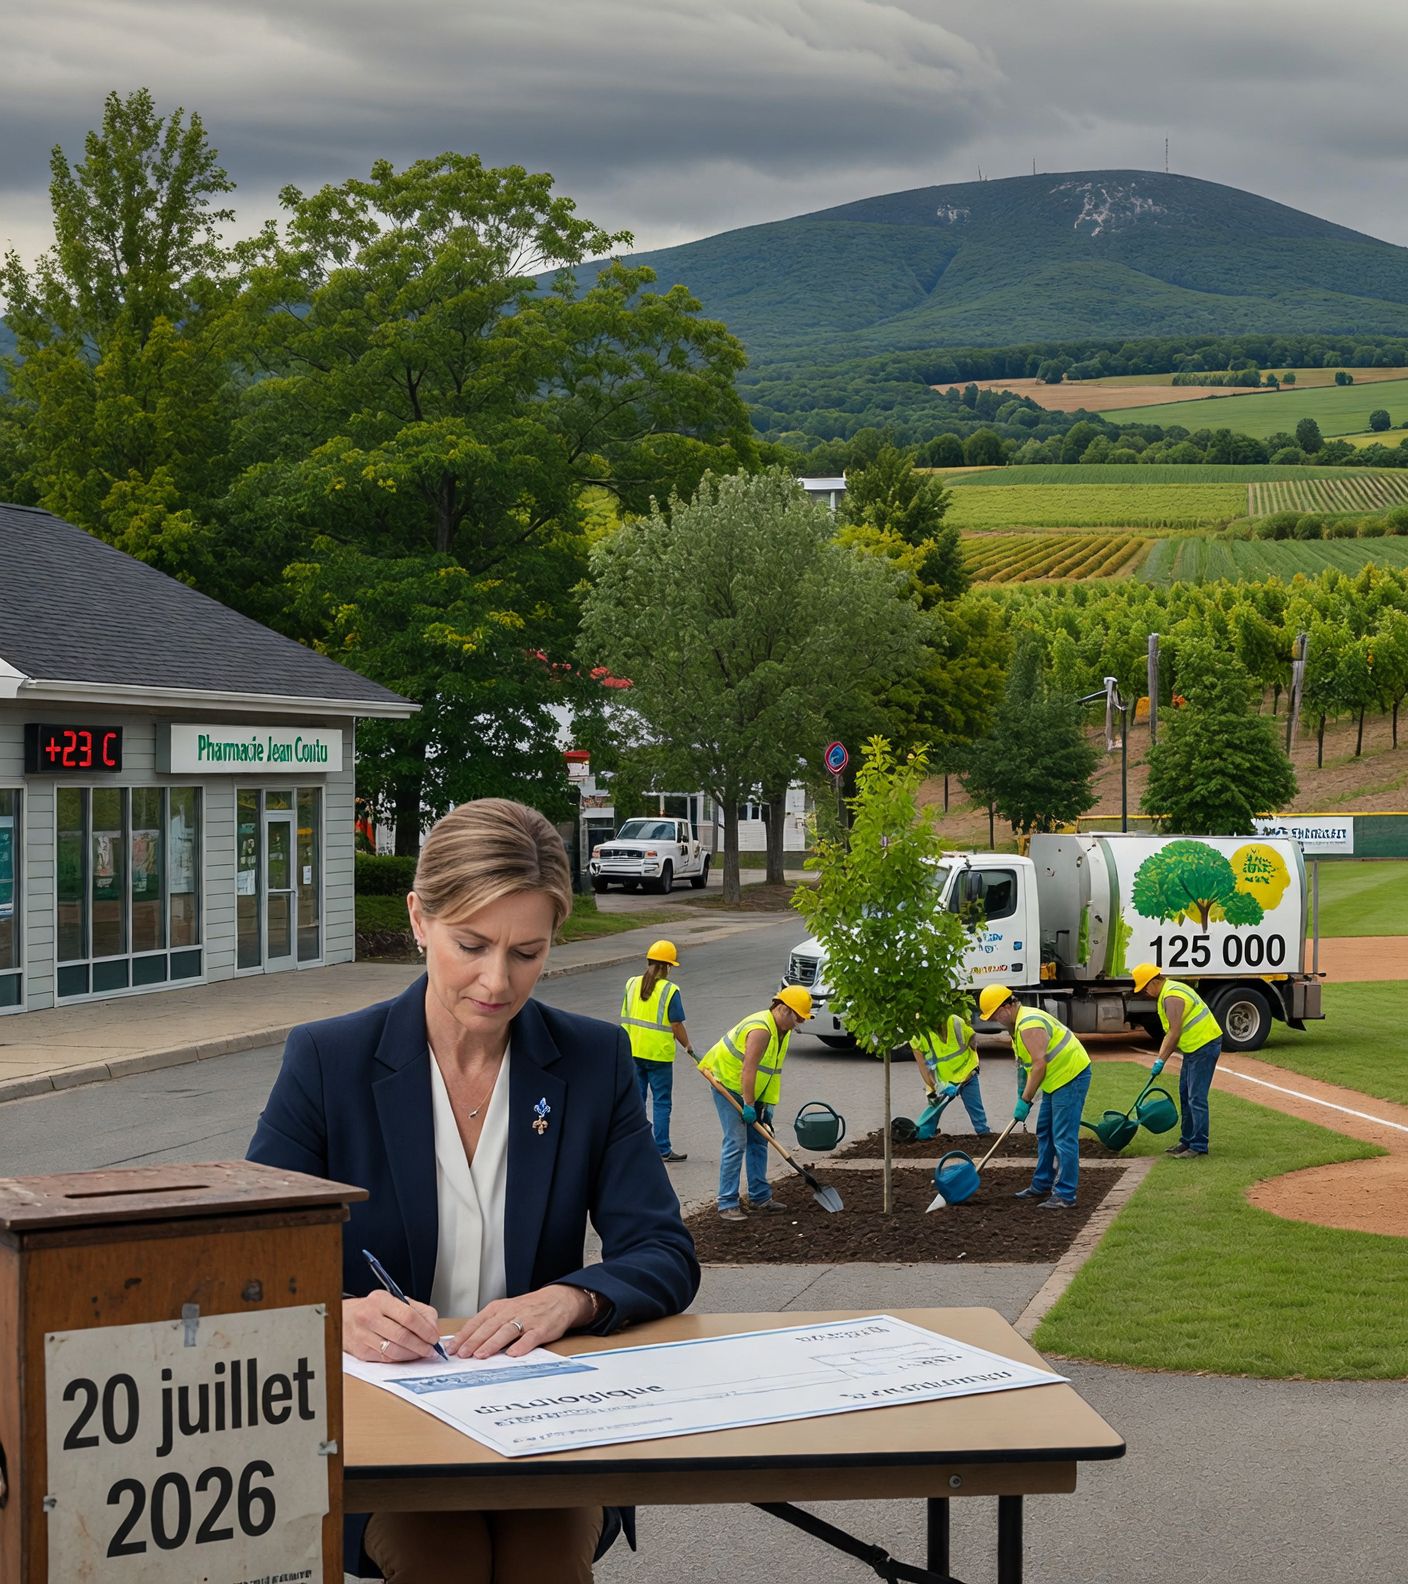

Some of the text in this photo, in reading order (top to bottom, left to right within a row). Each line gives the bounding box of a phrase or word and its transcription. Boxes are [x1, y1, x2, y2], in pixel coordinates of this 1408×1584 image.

[45, 730, 117, 767] +23 C
[198, 734, 264, 762] Pharmacie
[267, 736, 292, 762] Jean
[1150, 934, 1286, 968] 125 000
[62, 1357, 316, 1457] 20 juillet
[107, 1460, 276, 1558] 2026
